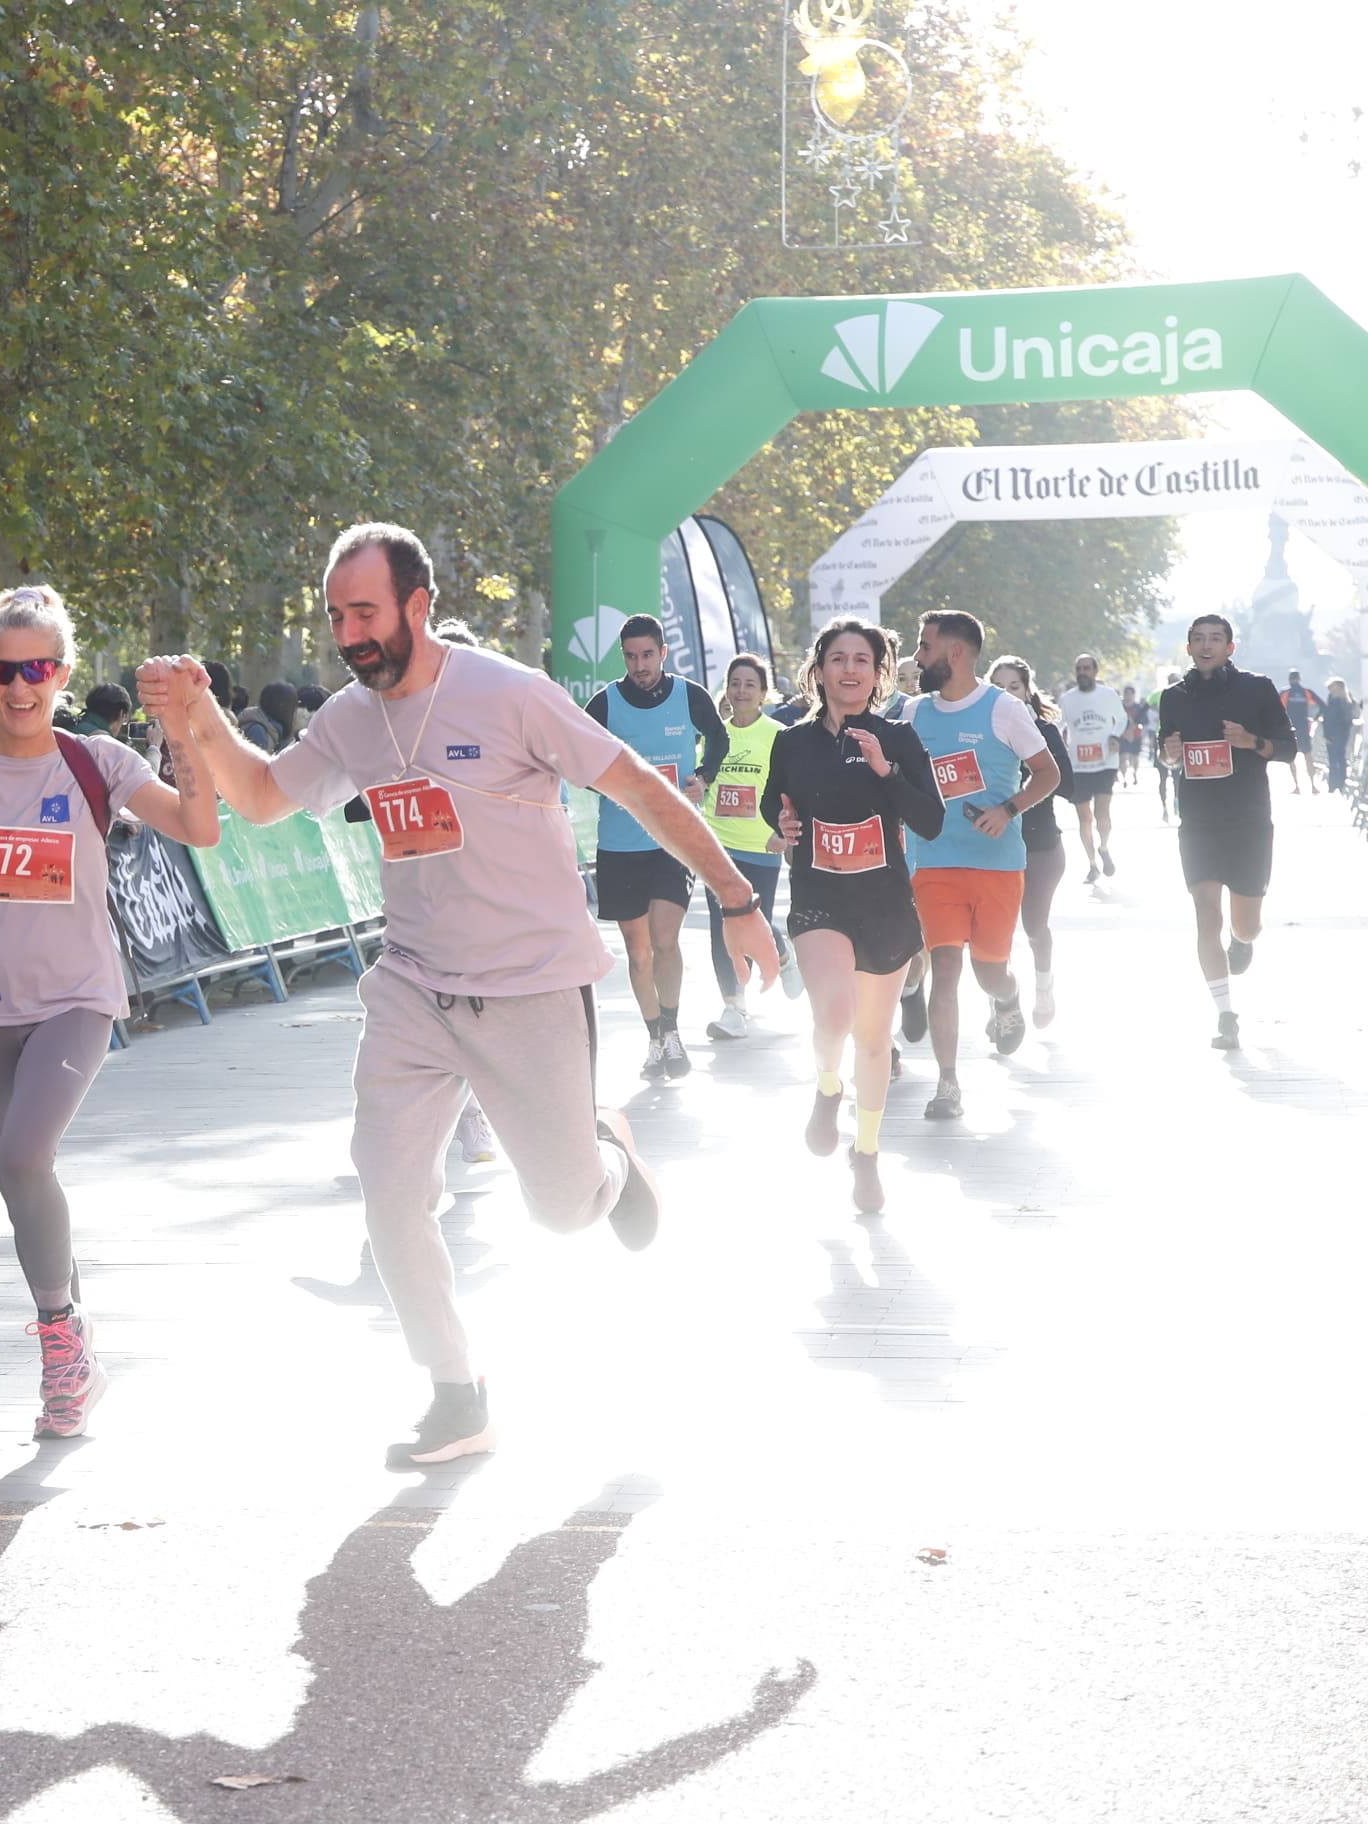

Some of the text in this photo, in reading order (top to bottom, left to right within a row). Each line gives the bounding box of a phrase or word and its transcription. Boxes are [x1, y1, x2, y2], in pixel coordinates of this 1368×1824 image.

[959, 315, 1223, 386] Unicaja
[962, 458, 1260, 502] El Norte de Castilla
[448, 749, 466, 758] AVL
[1188, 749, 1211, 766] 901
[719, 763, 761, 774] ICHELIN
[936, 764, 958, 785] 96
[720, 790, 740, 807] 526
[41, 815, 57, 823] AVL
[379, 796, 424, 832] 774
[821, 832, 855, 855] 497
